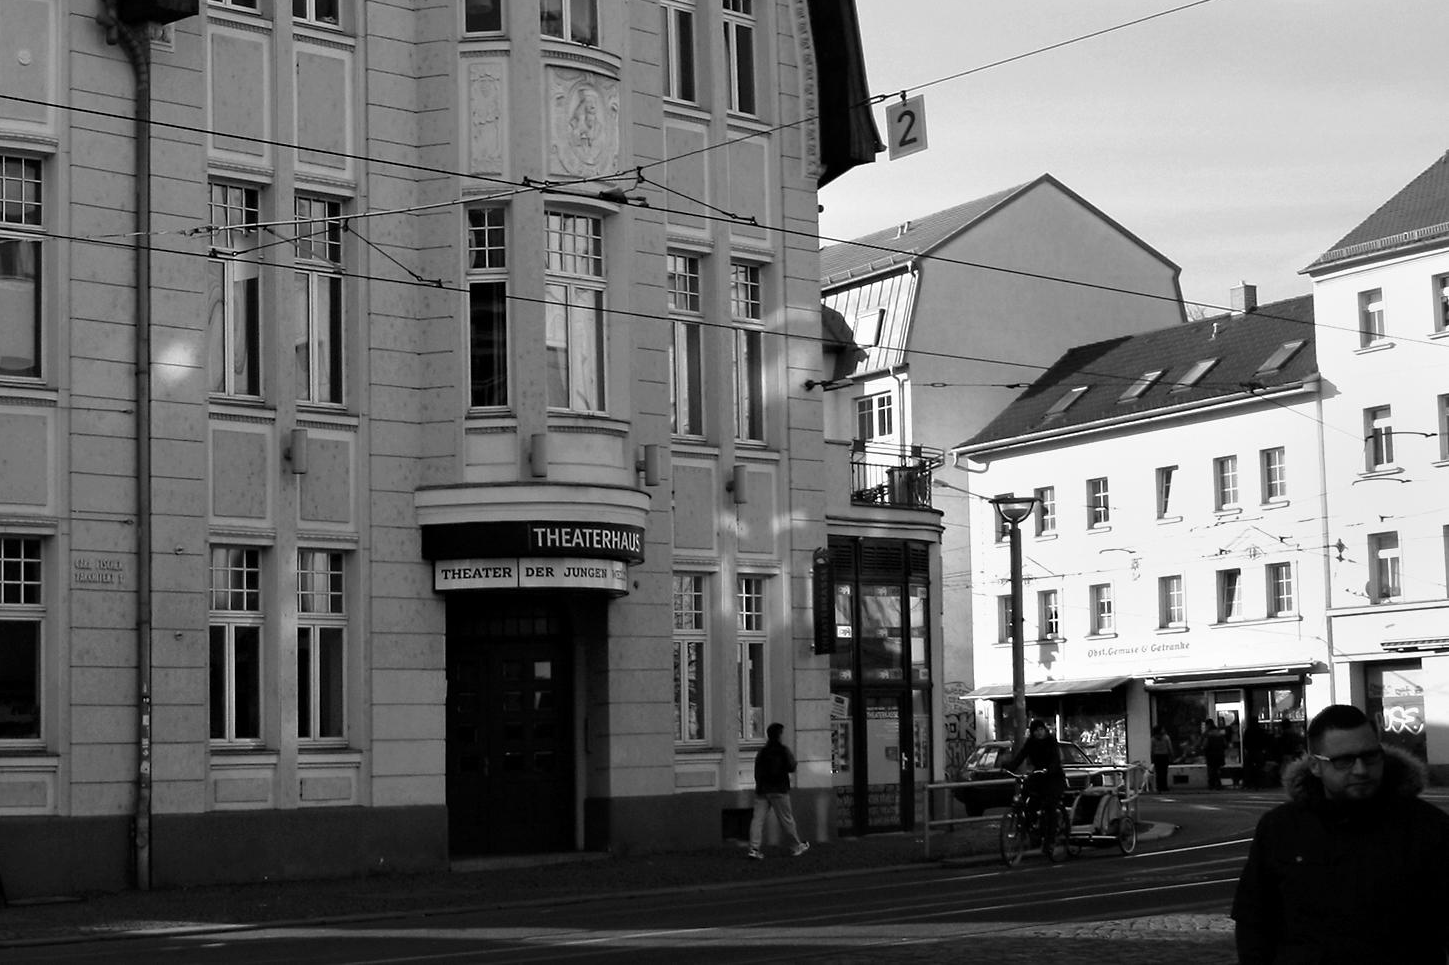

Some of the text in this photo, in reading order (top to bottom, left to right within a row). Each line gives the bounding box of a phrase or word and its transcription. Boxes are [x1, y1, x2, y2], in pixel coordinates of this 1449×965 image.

[898, 110, 916, 145] 2
[533, 527, 640, 553] THEATERHAUS
[441, 567, 513, 580] THEATER
[525, 567, 555, 578] DER
[563, 567, 607, 579] JUNGEN
